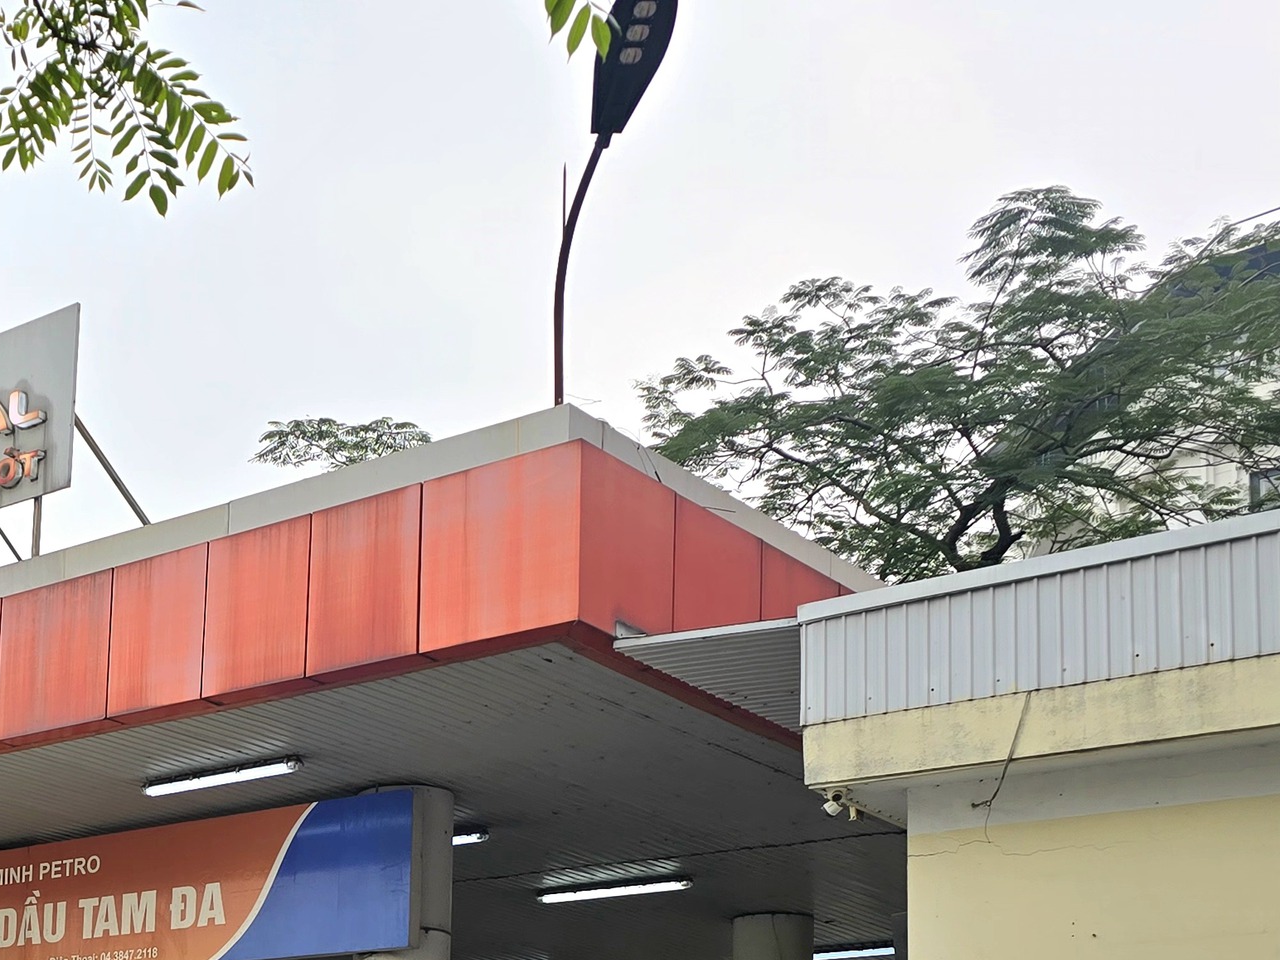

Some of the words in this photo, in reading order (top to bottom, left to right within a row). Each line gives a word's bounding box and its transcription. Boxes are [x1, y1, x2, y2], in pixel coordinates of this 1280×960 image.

[39, 855, 101, 880] PETRO
[78, 889, 156, 940] TAM
[170, 882, 226, 930] ĐA
